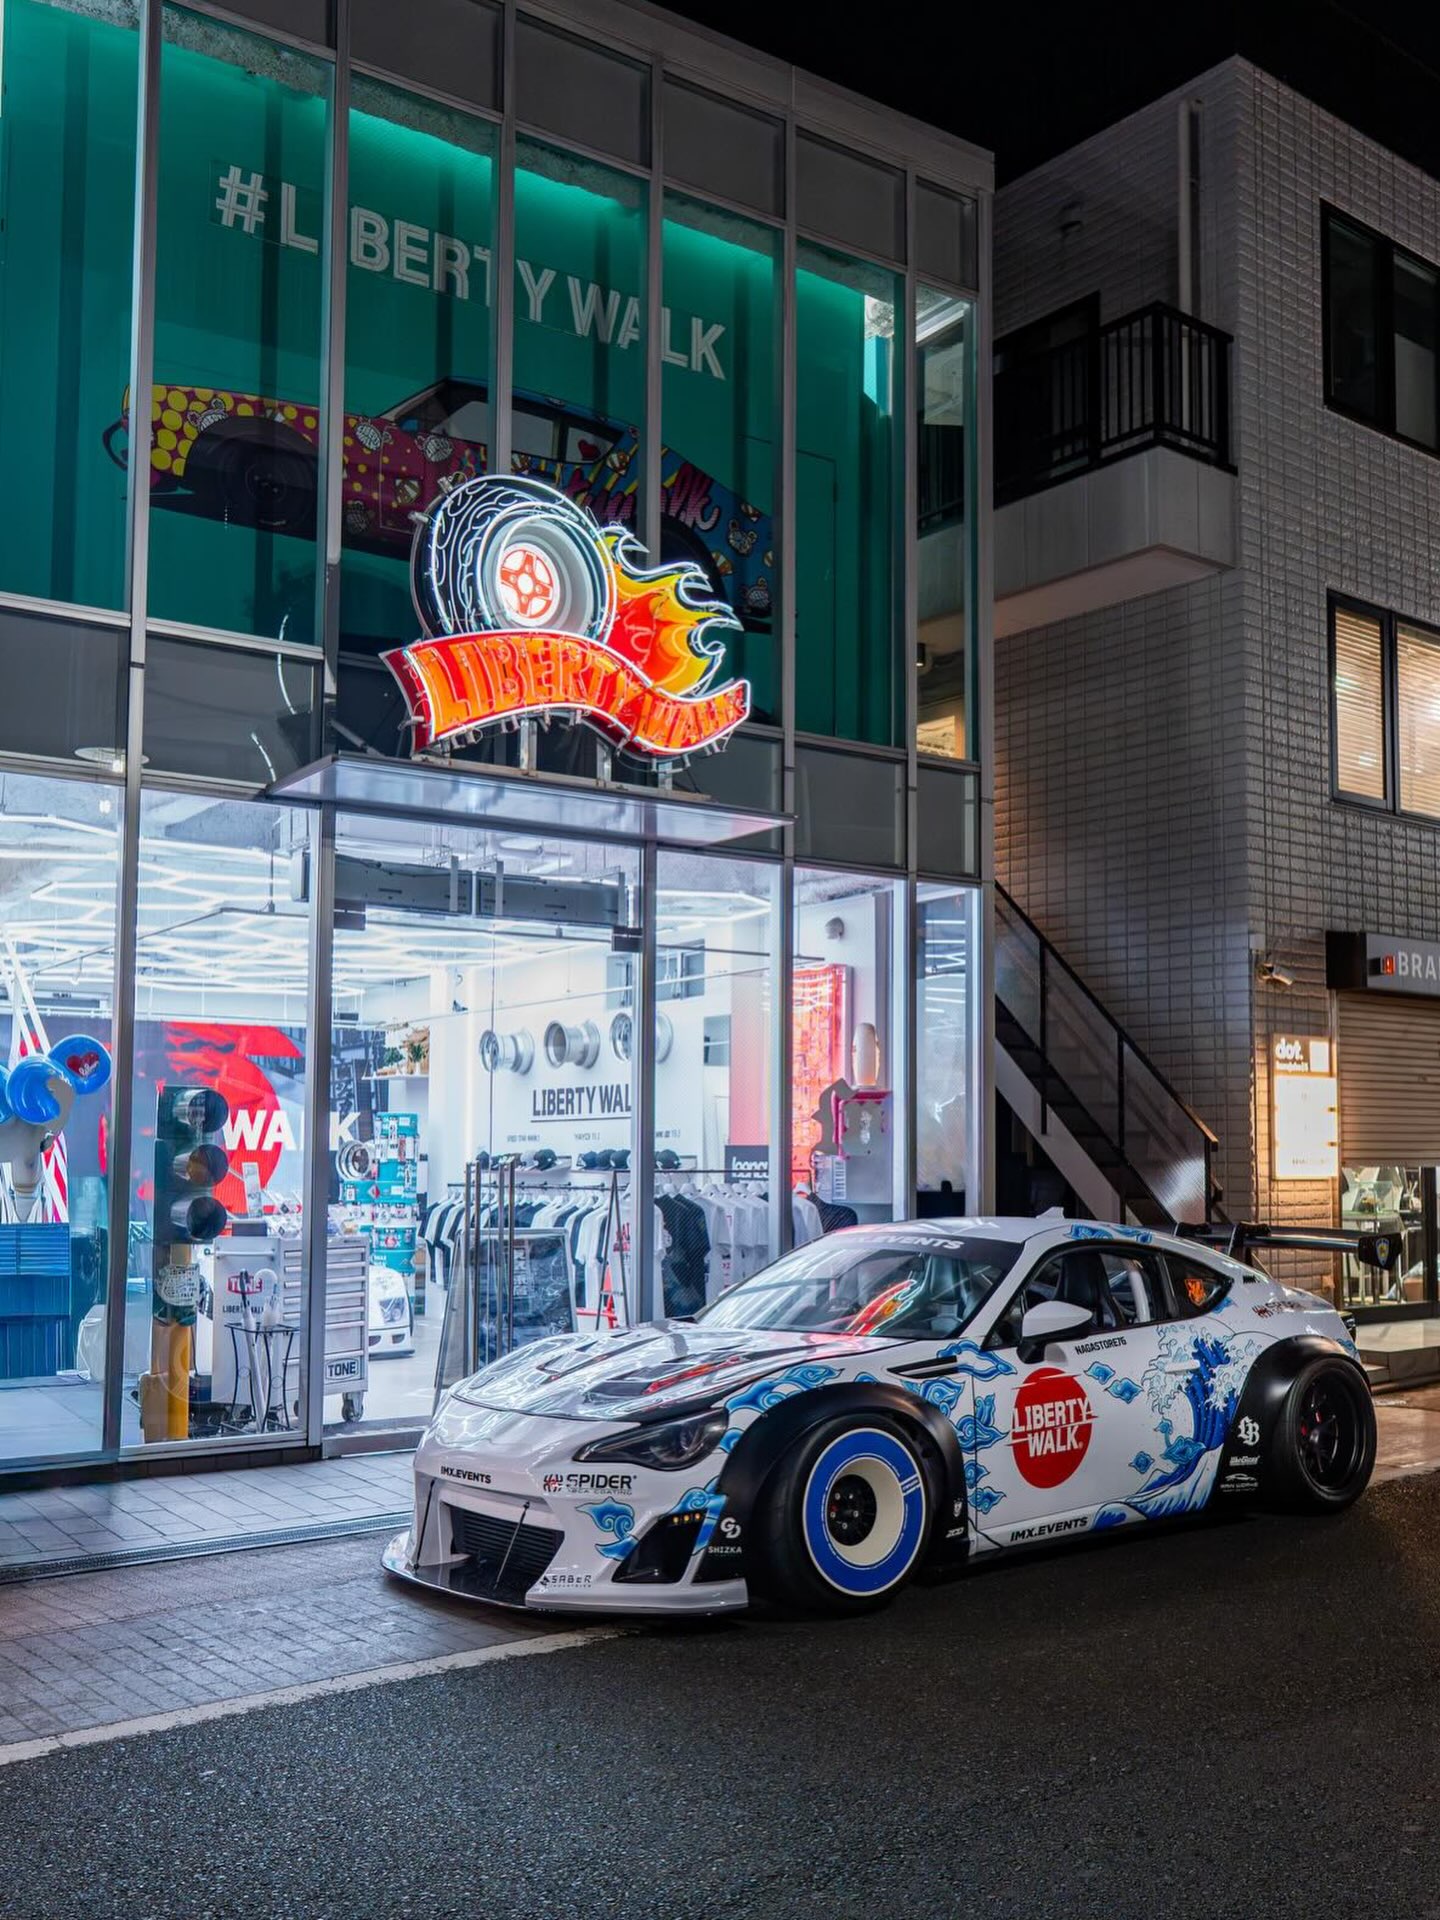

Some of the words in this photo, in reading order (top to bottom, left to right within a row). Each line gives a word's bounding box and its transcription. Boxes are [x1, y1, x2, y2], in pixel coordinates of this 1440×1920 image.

[216, 165, 557, 322] #LBERTY
[420, 637, 646, 736] LIBERTY
[1398, 951, 1440, 980] BRA
[532, 1086, 597, 1116] LIBERTY
[599, 1083, 632, 1114] WAL
[222, 1109, 361, 1151] WAK
[1074, 1336, 1128, 1355] NAGASTORE76
[327, 1361, 357, 1377] TONE
[1011, 1397, 1092, 1434] LIBERTY
[440, 1465, 492, 1484] IMX.EVENTS
[1009, 1516, 1088, 1542] IMX.EVENTS
